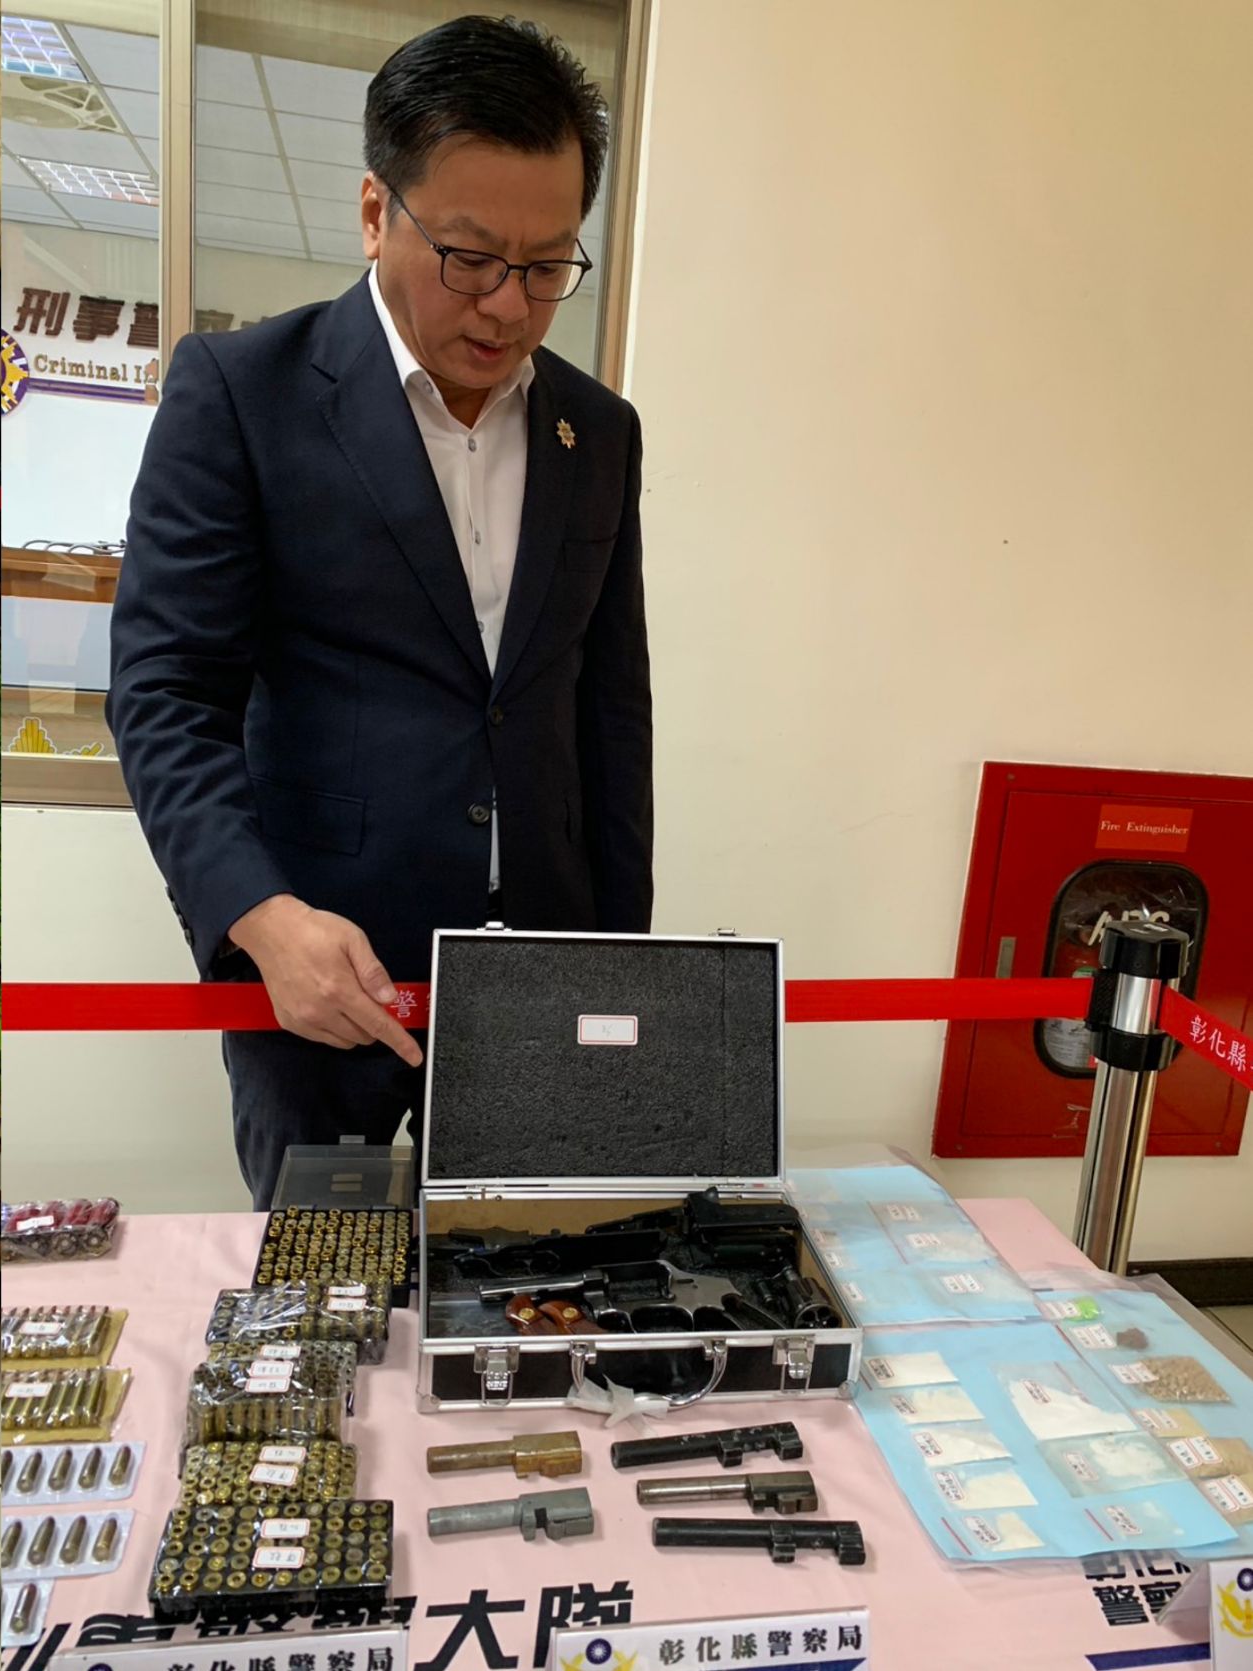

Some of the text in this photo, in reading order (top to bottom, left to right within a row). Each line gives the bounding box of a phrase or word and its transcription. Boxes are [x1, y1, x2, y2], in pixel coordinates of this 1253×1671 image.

[34, 354, 128, 382] Criminal
[1100, 820, 1189, 837] Fire Extinguisher
[658, 1624, 864, 1667] 彰化縣警察局
